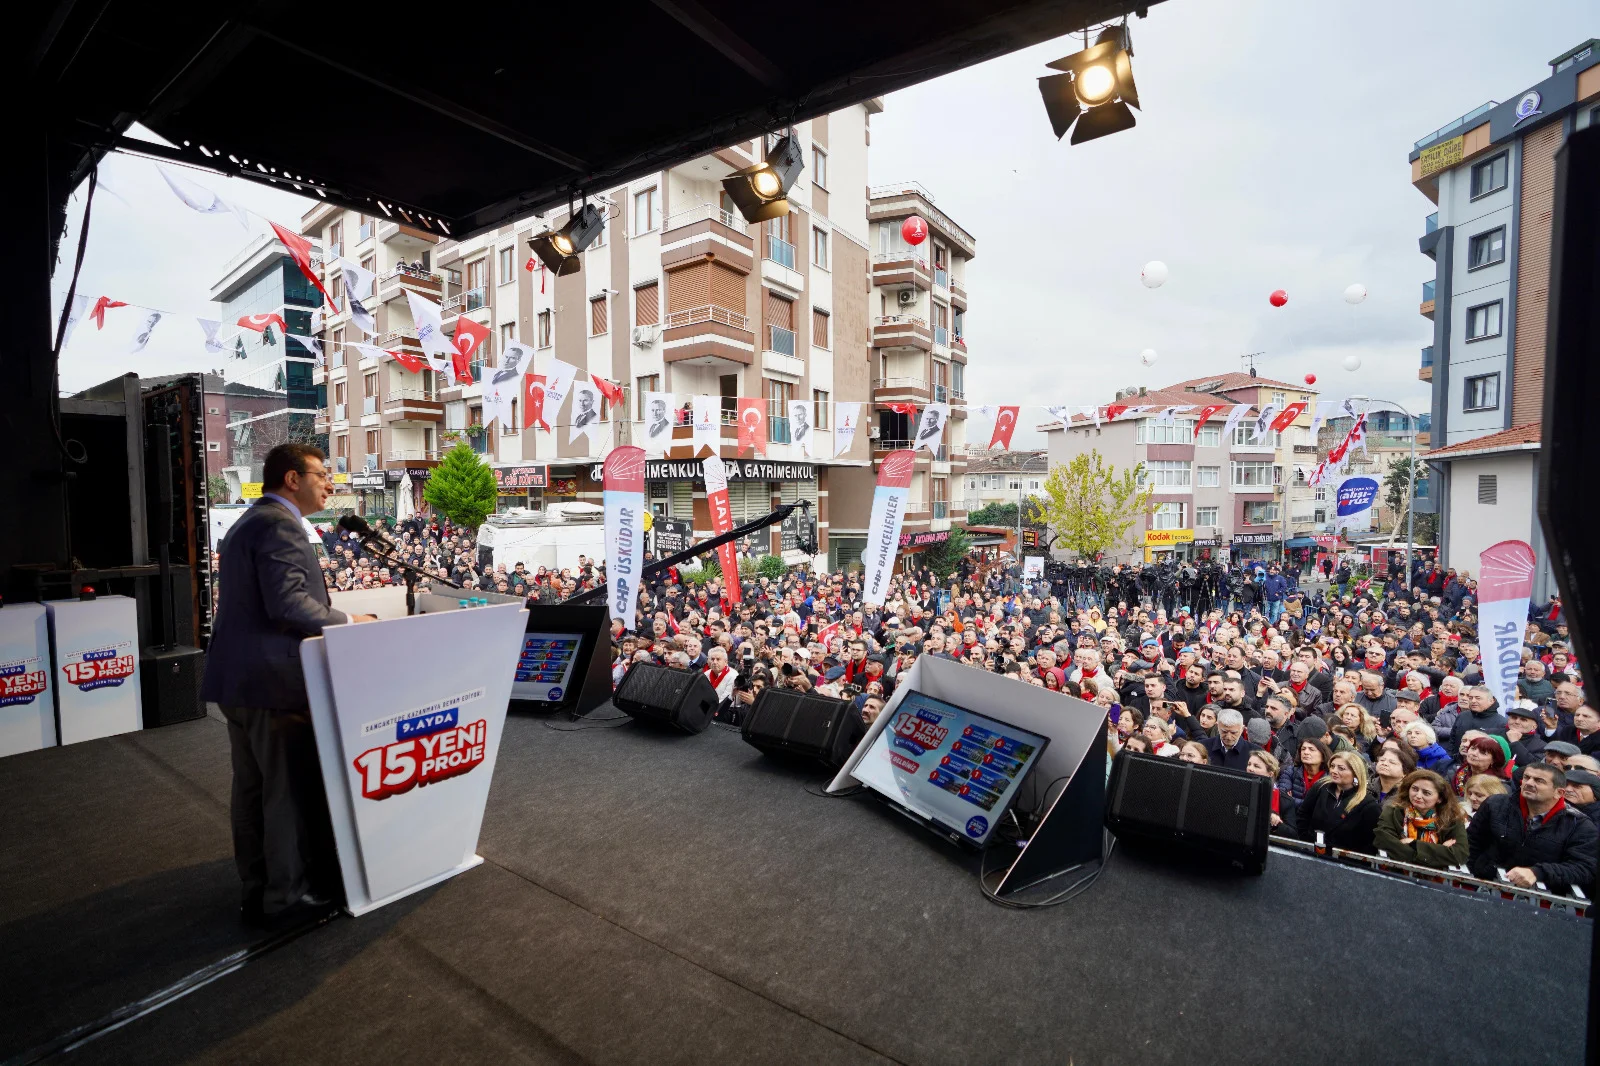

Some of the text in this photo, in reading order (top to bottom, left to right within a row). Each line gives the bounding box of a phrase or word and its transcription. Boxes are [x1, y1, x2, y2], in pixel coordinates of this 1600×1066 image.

[744, 462, 814, 479] GAYRİMENKUL
[871, 495, 899, 595] CHP BAHÇELİEVLER
[1147, 532, 1171, 541] Kodak
[613, 507, 634, 614] CHP ÜSKÜDAR
[93, 650, 114, 659] AYDA
[98, 655, 133, 670] YENİ
[3, 671, 45, 687] YENİ
[65, 661, 96, 681] 15
[98, 667, 134, 677] PROJE
[4, 682, 45, 695] PROJE
[365, 715, 405, 733] SANCAKTEPE
[406, 702, 441, 719] KAZANMAYA
[442, 697, 460, 707] DEVAM
[402, 712, 453, 734] 9. AYDA
[895, 714, 921, 735] 15
[419, 721, 485, 759] YENİ
[912, 731, 941, 748] PROJE
[919, 720, 948, 740] YENİ
[357, 740, 417, 794] 15
[421, 744, 483, 777] PROJE
